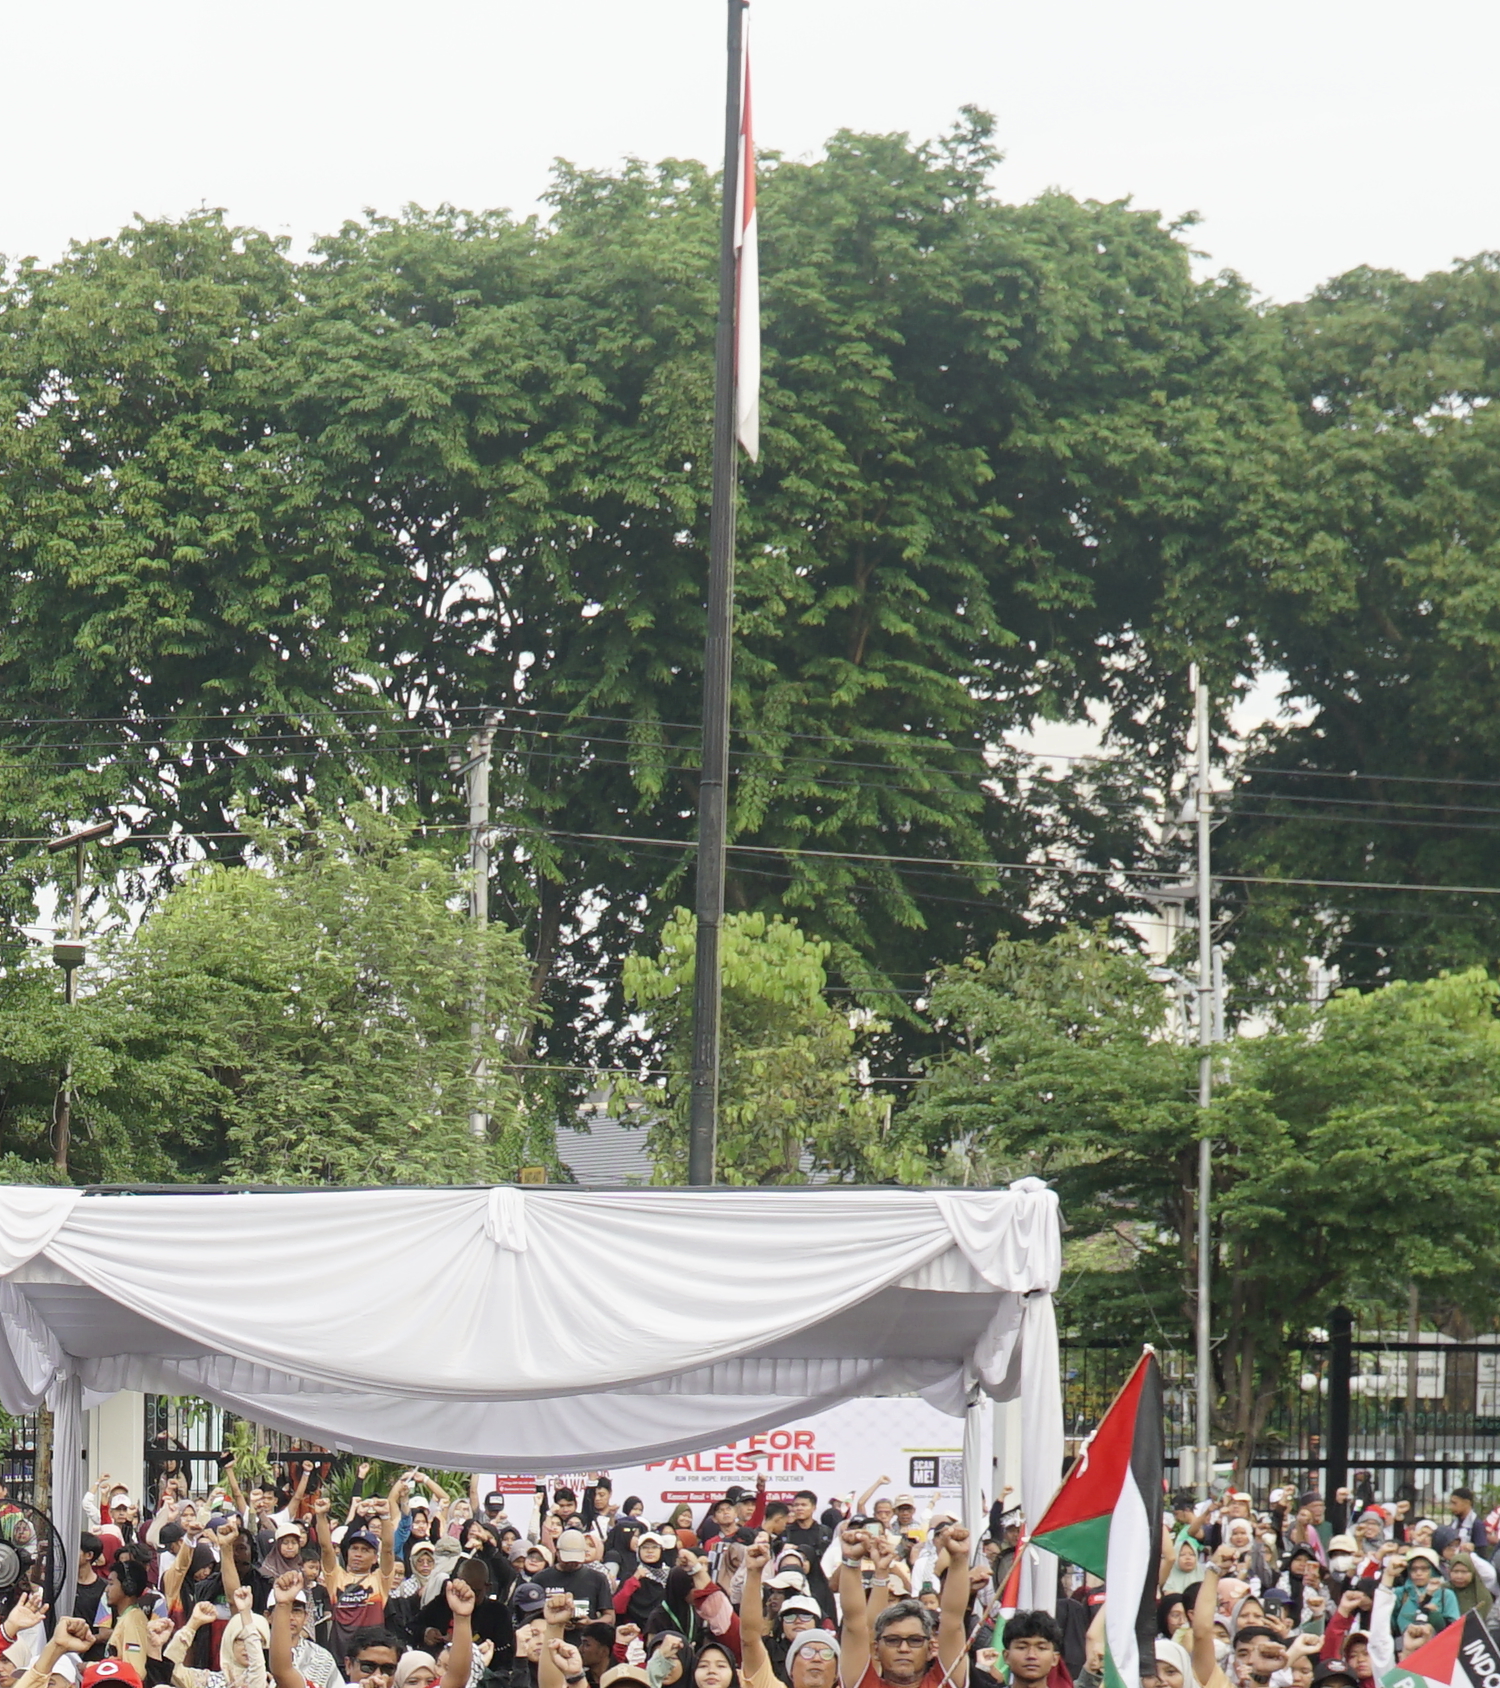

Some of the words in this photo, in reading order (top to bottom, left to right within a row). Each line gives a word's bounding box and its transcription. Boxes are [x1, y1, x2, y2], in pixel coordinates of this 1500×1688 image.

[749, 1430, 816, 1450] FOR
[913, 1460, 935, 1469] SCAN
[913, 1469, 935, 1484] ME!
